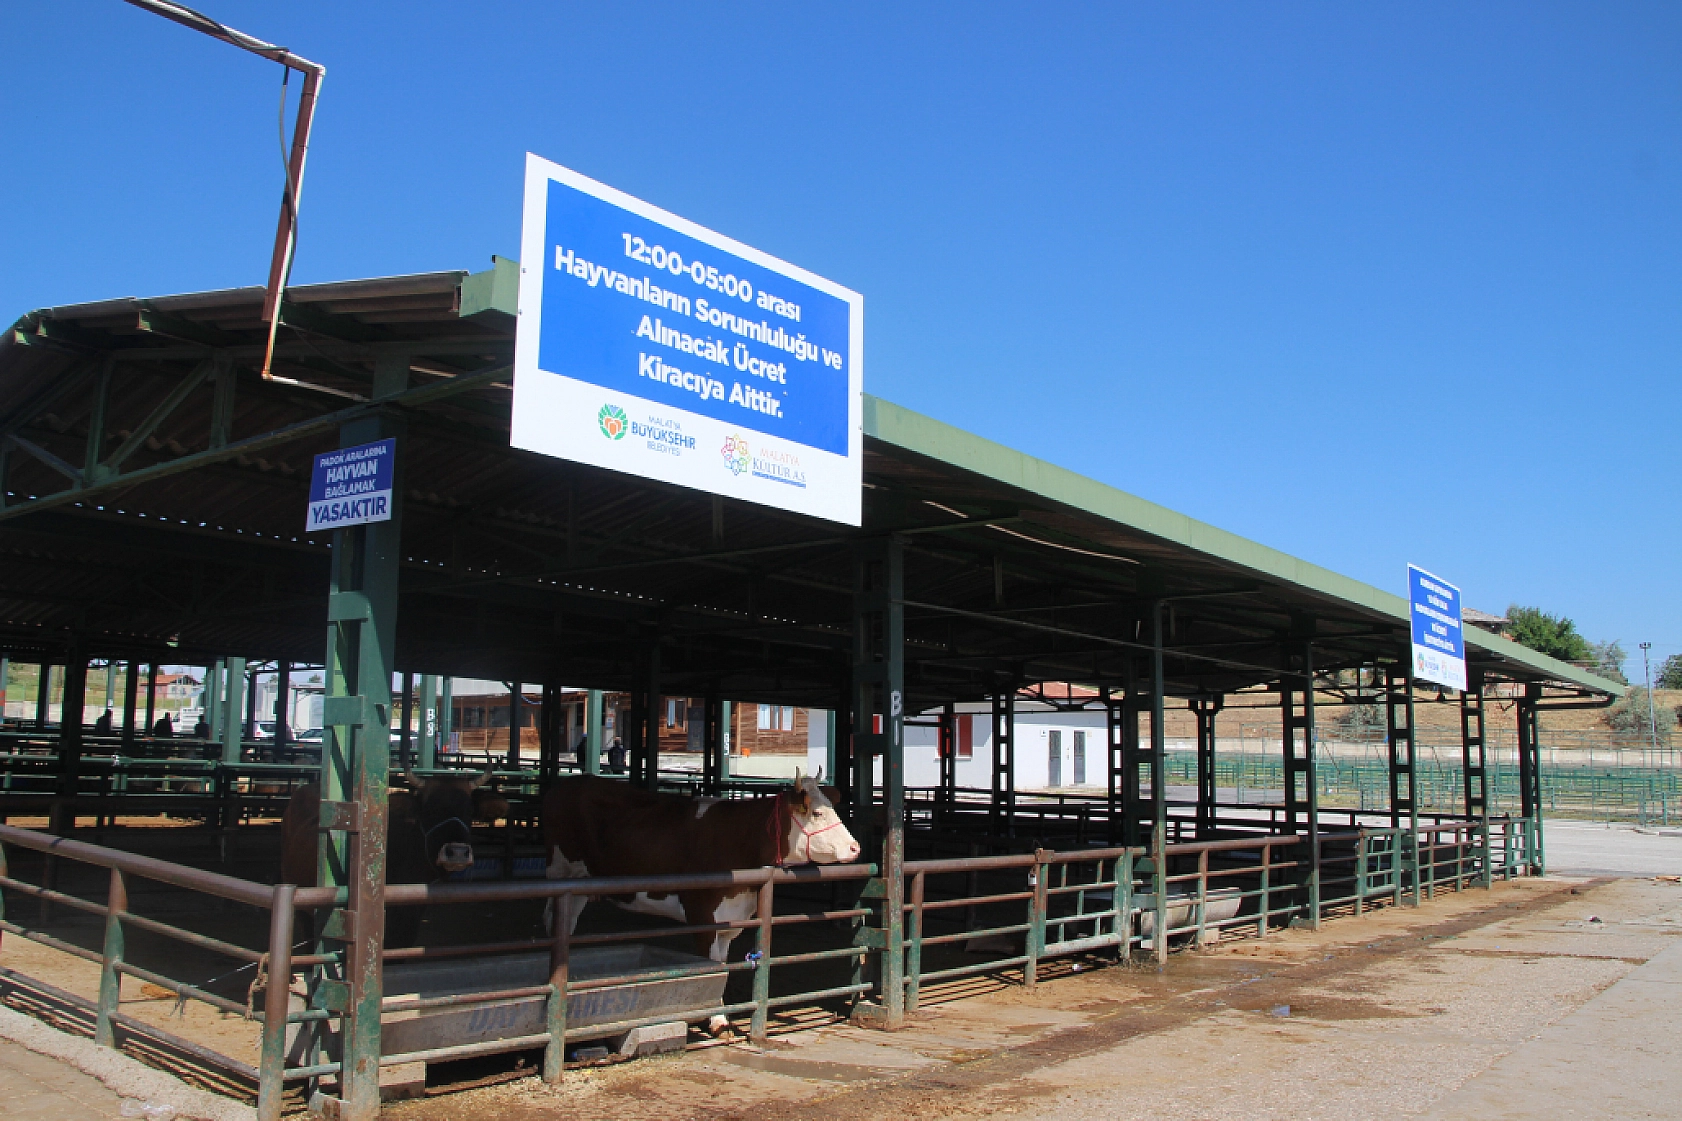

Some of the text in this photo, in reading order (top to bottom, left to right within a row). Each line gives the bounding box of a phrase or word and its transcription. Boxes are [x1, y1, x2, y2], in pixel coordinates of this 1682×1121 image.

[622, 232, 801, 322] 12:00-05:00 arası
[555, 245, 843, 370] Hayvanların Sorumluluğu ve
[636, 315, 786, 385] Alınacak Ücret
[639, 353, 784, 418] Kiracıya Aittir.
[649, 415, 682, 431] MALATYA
[326, 459, 378, 484] HAYVAN
[760, 448, 800, 467] MALATYA
[312, 496, 387, 524] YASAKTIR
